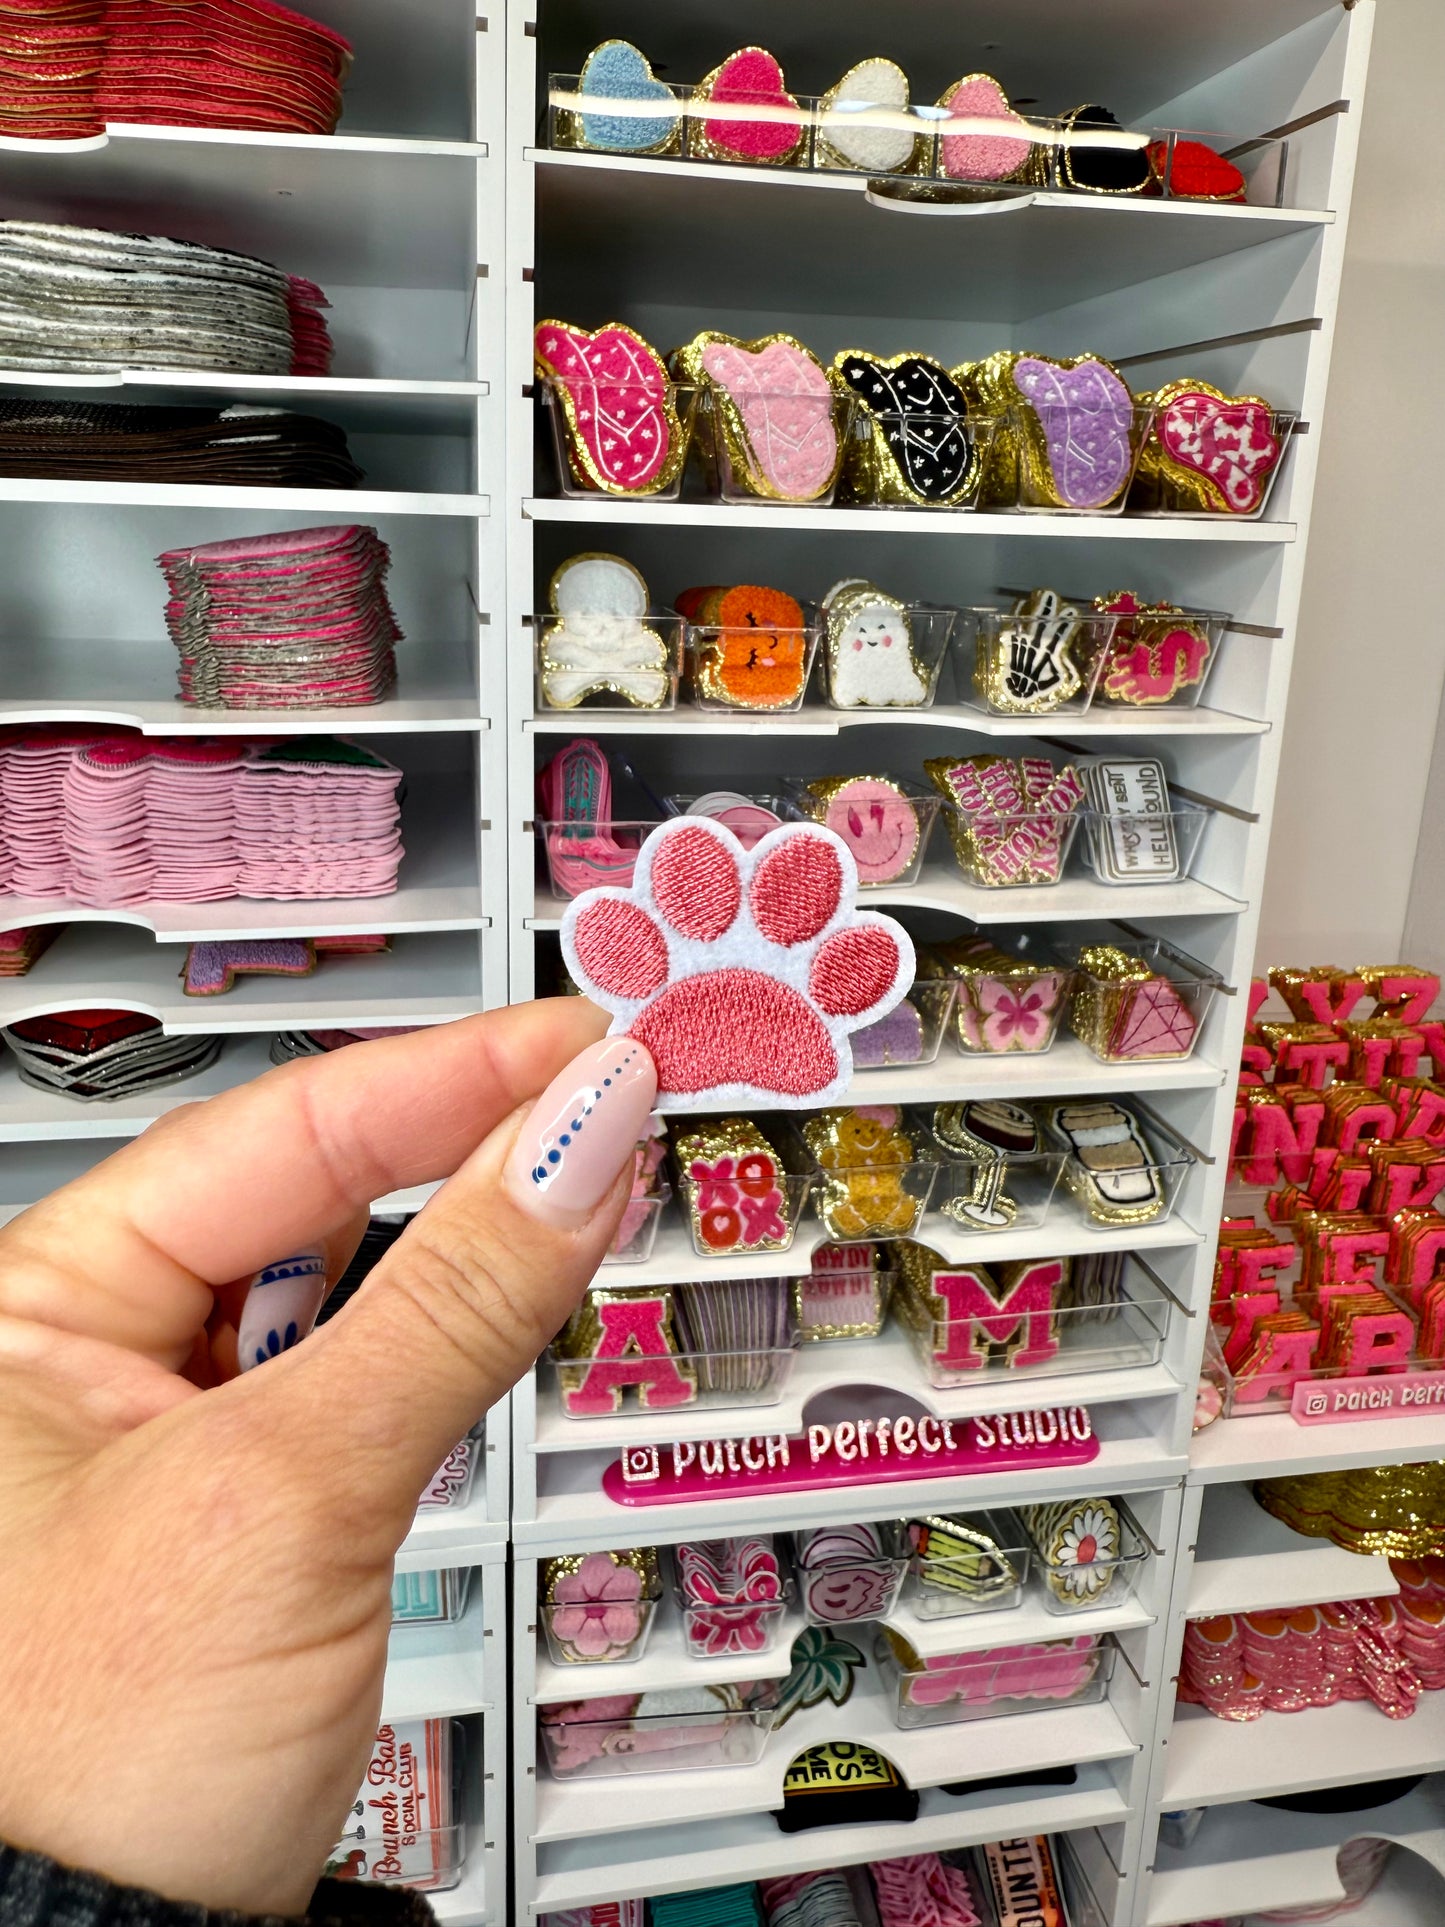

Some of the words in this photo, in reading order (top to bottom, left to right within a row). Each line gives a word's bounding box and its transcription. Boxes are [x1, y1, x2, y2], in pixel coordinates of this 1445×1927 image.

[399, 1741, 413, 1789] CLUB
[368, 1791, 402, 1880] Brunch
[401, 1790, 417, 1846] SOCIAL
